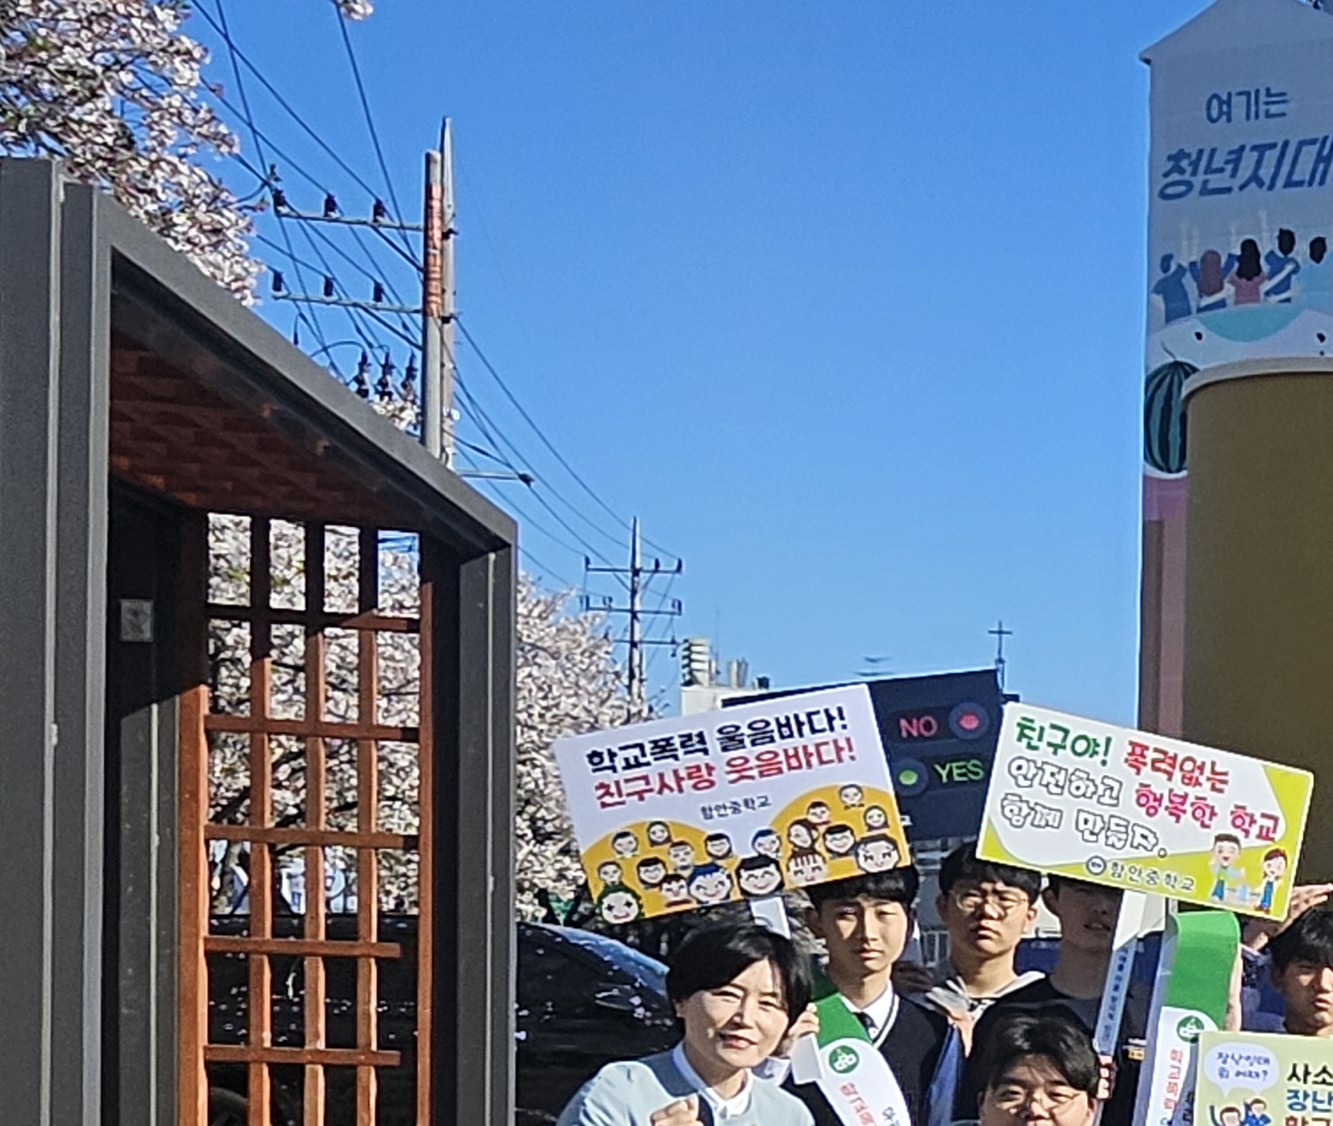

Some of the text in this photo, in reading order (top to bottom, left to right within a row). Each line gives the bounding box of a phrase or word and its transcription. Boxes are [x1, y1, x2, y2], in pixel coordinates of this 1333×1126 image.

[1206, 87, 1288, 124] 여기는
[585, 706, 847, 774] 학교폭력 울음바다!
[900, 717, 938, 737] NO
[933, 761, 984, 782] YES
[1015, 716, 1230, 793] 친구야! 폭력없는
[594, 737, 856, 809] 친구사랑 웃음바다!
[701, 795, 771, 821] 함안중학교
[1002, 793, 1062, 828] 함께
[1008, 756, 1280, 842] 안전하고 행복한 학교
[1109, 861, 1195, 891] 함안중학교
